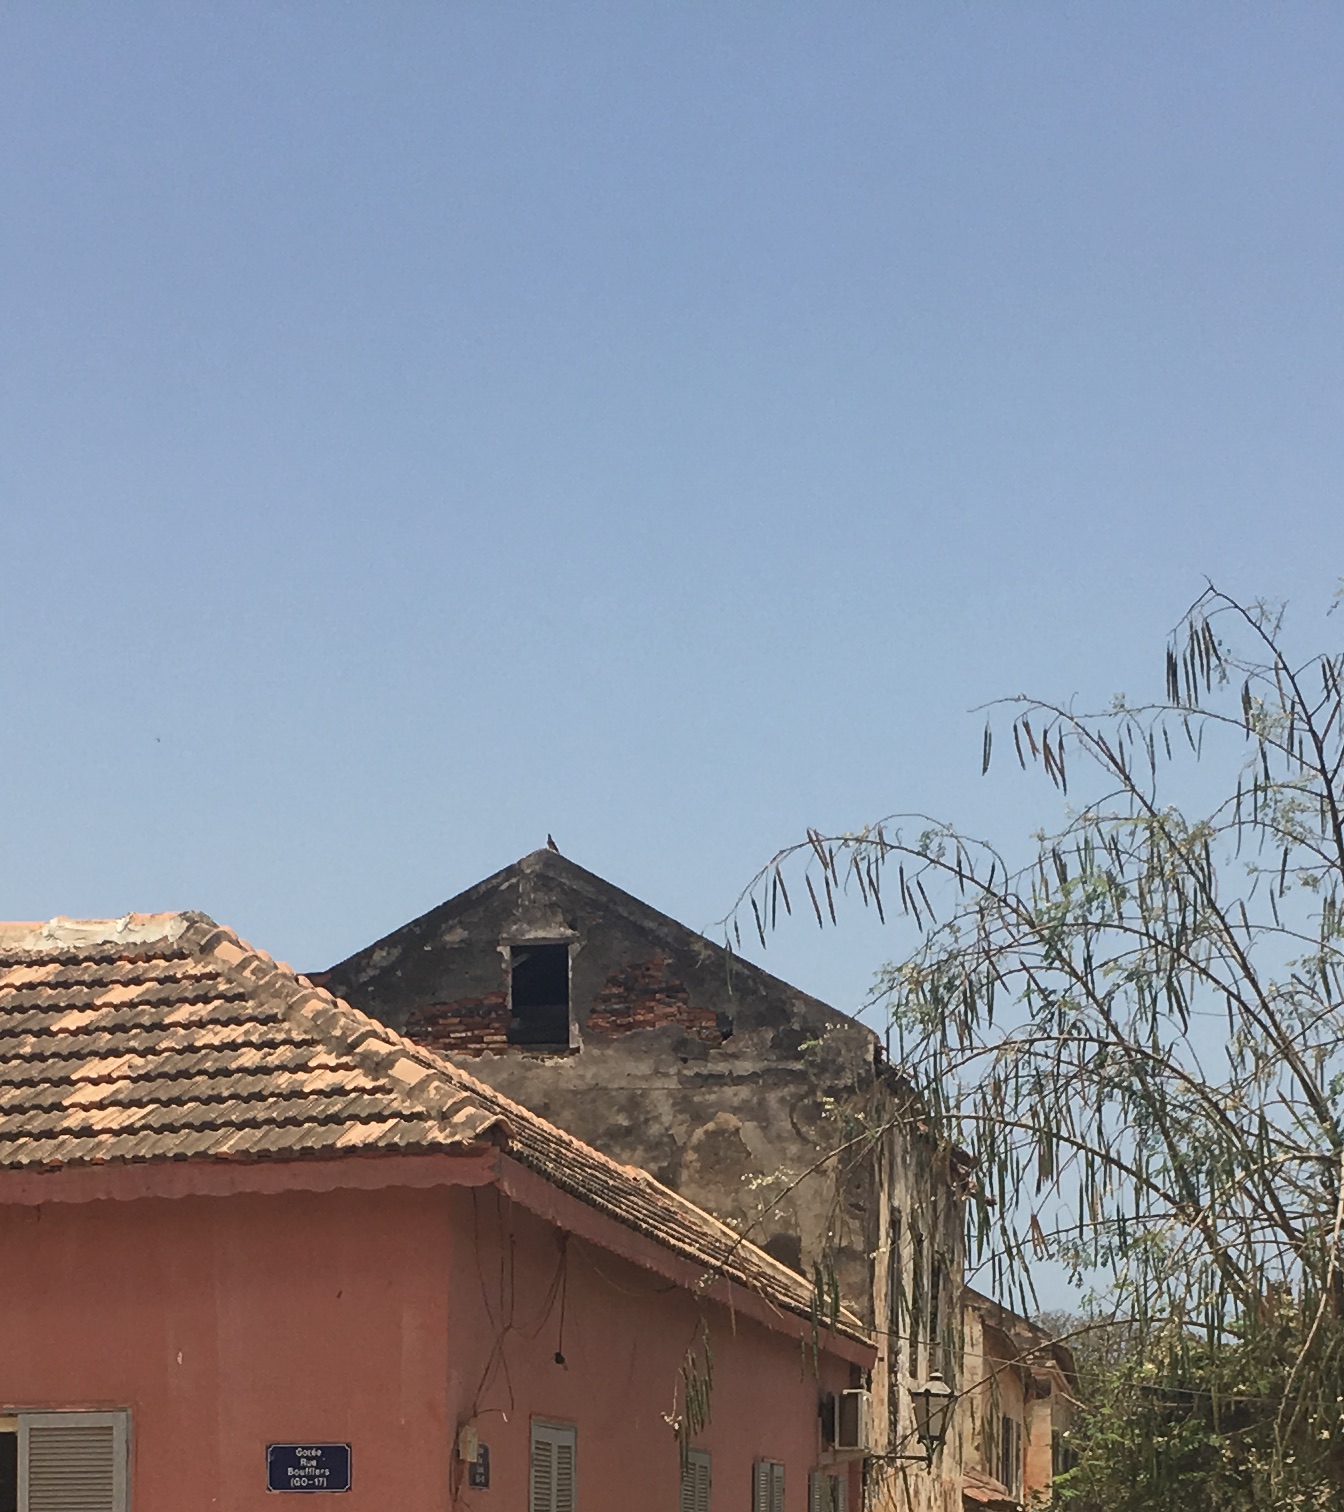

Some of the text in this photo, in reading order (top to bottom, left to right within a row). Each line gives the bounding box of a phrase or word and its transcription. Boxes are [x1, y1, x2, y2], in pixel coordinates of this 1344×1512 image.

[296, 1448, 322, 1457] Gorée
[300, 1458, 317, 1467] Rue
[287, 1467, 330, 1476] Boufflers
